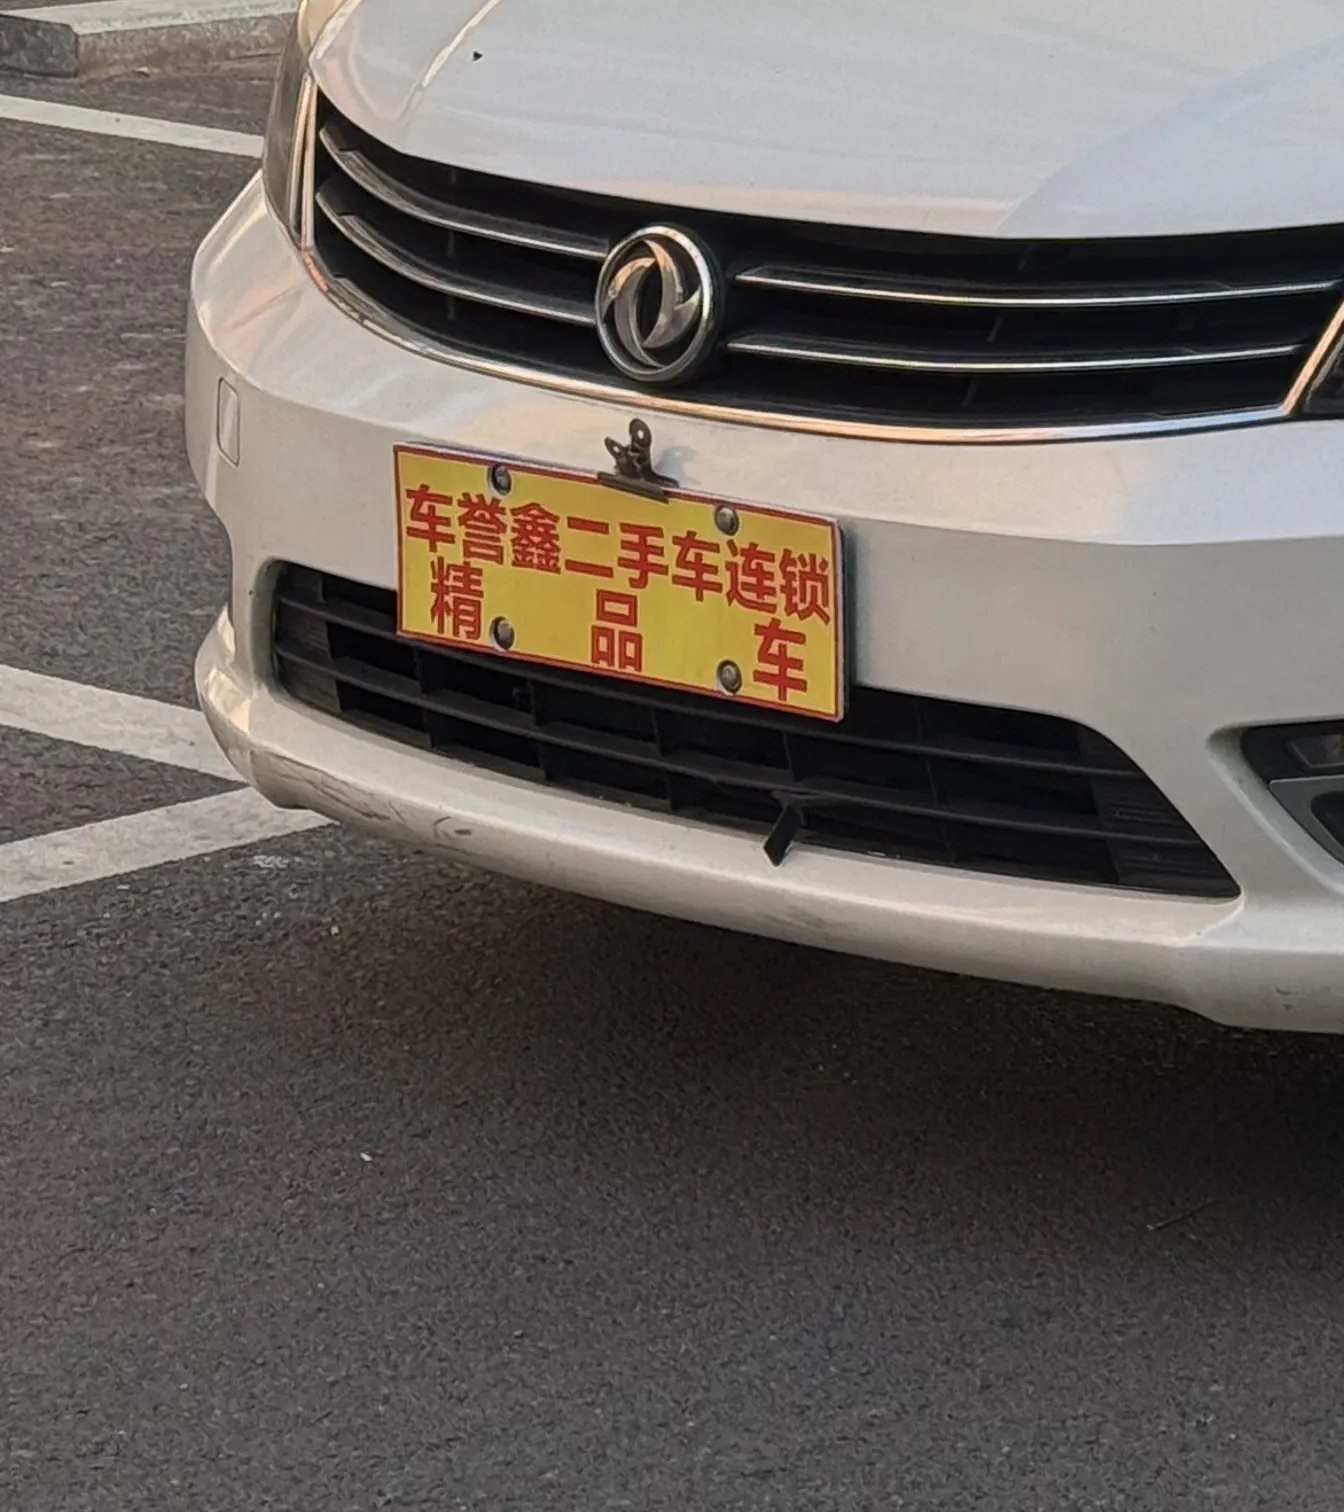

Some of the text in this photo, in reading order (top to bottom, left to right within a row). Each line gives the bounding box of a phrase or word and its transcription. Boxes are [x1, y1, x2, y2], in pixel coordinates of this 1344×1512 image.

[405, 484, 832, 625] 车誉鑫二手车连锁
